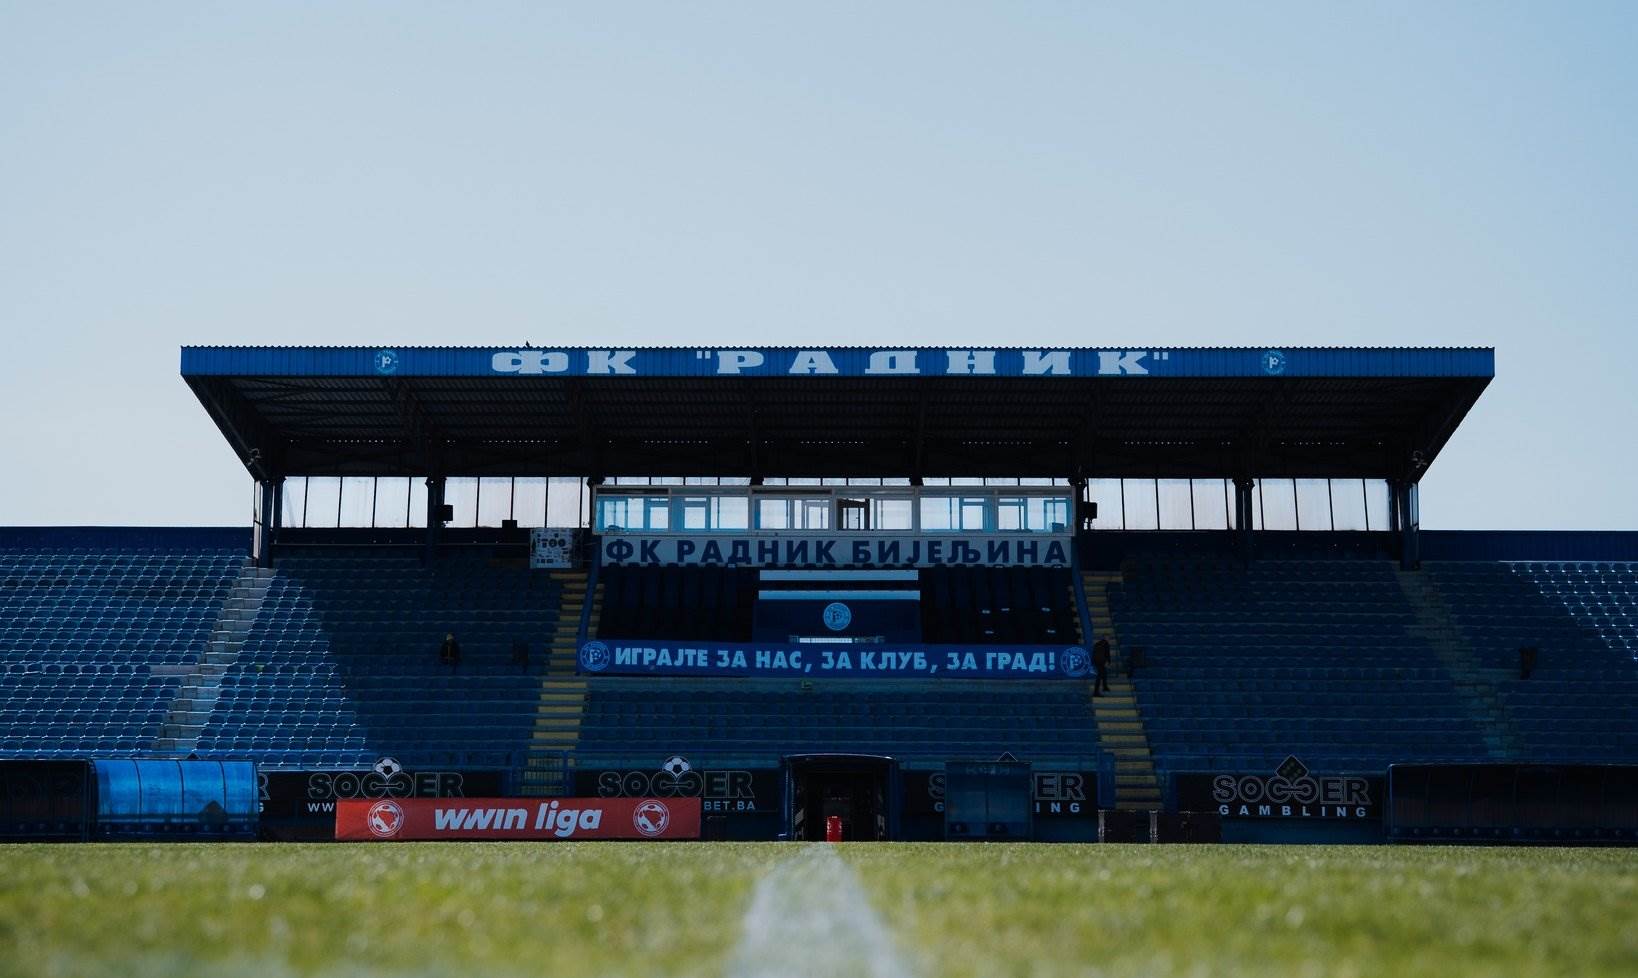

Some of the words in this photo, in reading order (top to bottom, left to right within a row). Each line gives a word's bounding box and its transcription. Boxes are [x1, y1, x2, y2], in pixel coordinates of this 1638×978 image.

[492, 350, 636, 374] ФК
[697, 350, 1168, 374] "РАДНИК"
[605, 538, 661, 562] ФК
[677, 539, 837, 565] РАДНИК
[852, 540, 1067, 564] БИЈЕЉИНА
[615, 647, 708, 667] ИГРАЈТЕ
[716, 650, 748, 669] ЗА
[755, 650, 812, 672] НАС,
[821, 651, 852, 670] ЗА
[860, 651, 938, 673] КЛУБ,
[947, 652, 978, 670] ЗА
[986, 651, 1056, 672] ГРАД!
[308, 772, 465, 799] SOCCER
[598, 771, 756, 798] SOCCER
[1212, 774, 1373, 804] SOCCER
[535, 800, 602, 838] liga
[704, 801, 756, 811] BET.BA
[1219, 804, 1367, 817] GAMBLING
